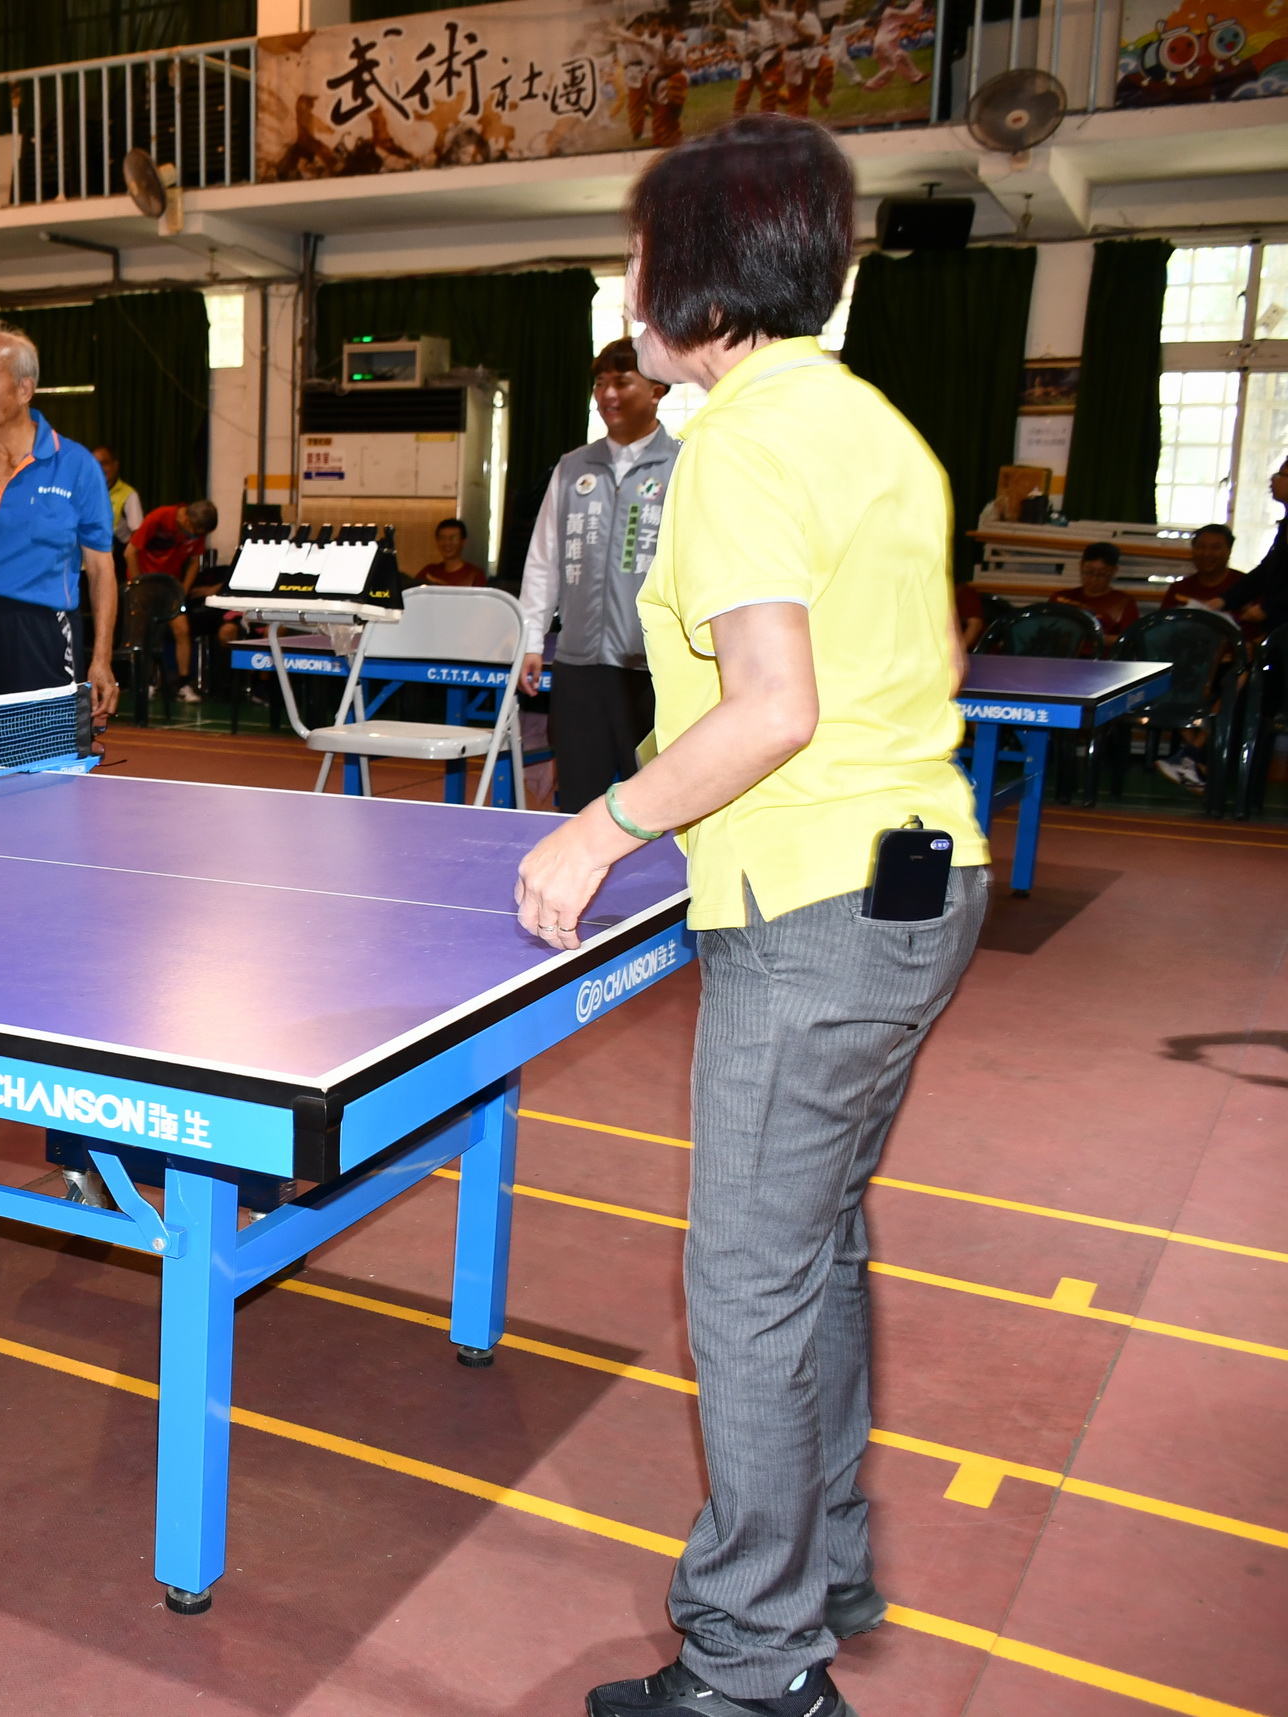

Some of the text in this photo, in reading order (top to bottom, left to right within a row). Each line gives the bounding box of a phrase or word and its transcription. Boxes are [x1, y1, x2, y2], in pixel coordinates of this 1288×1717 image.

[326, 22, 597, 125] 武術社團
[369, 589, 391, 598] LEX
[283, 658, 322, 671] ANSON
[427, 668, 485, 684] C.T.T.T.A.
[603, 948, 658, 1003] CHANSON
